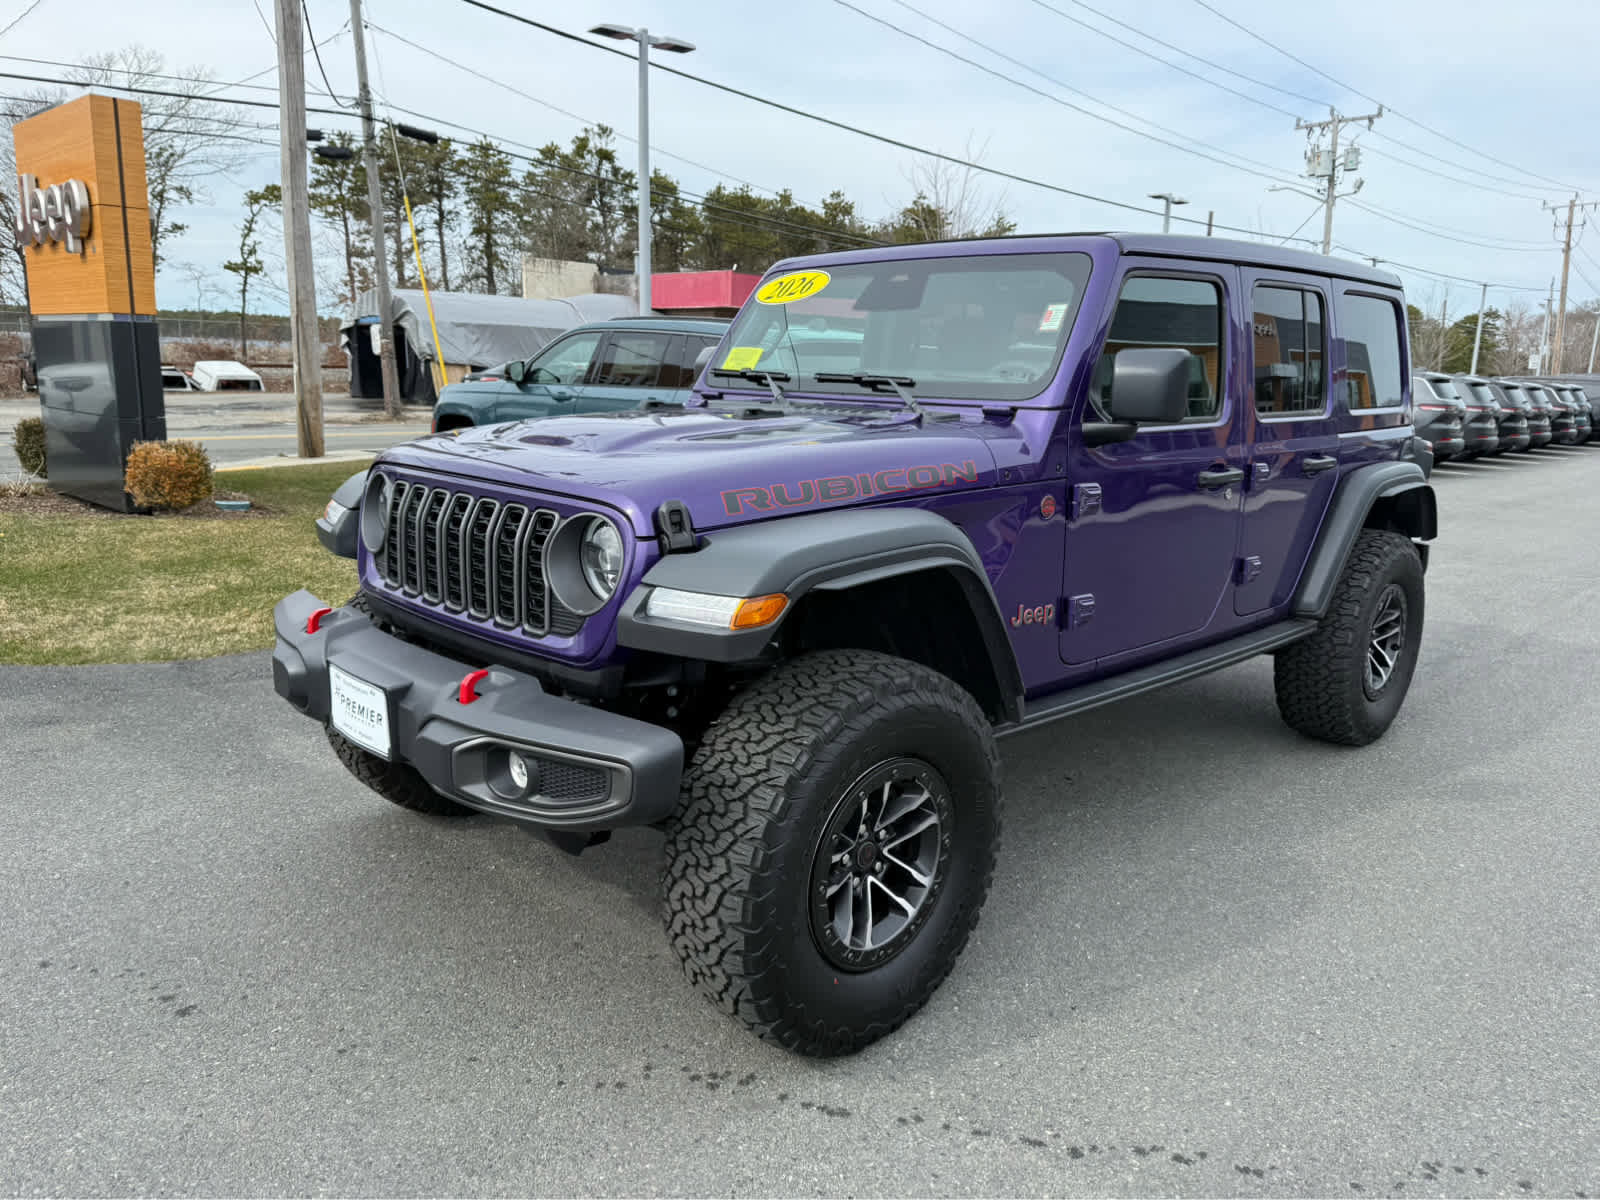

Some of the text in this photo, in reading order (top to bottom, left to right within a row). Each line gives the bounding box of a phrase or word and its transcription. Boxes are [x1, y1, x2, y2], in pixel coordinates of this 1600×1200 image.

[15, 173, 90, 253] Jeep
[764, 275, 821, 300] 2026
[720, 461, 979, 516] RUBICON
[1011, 604, 1055, 626] Jeep
[340, 694, 384, 725] PREMIER
